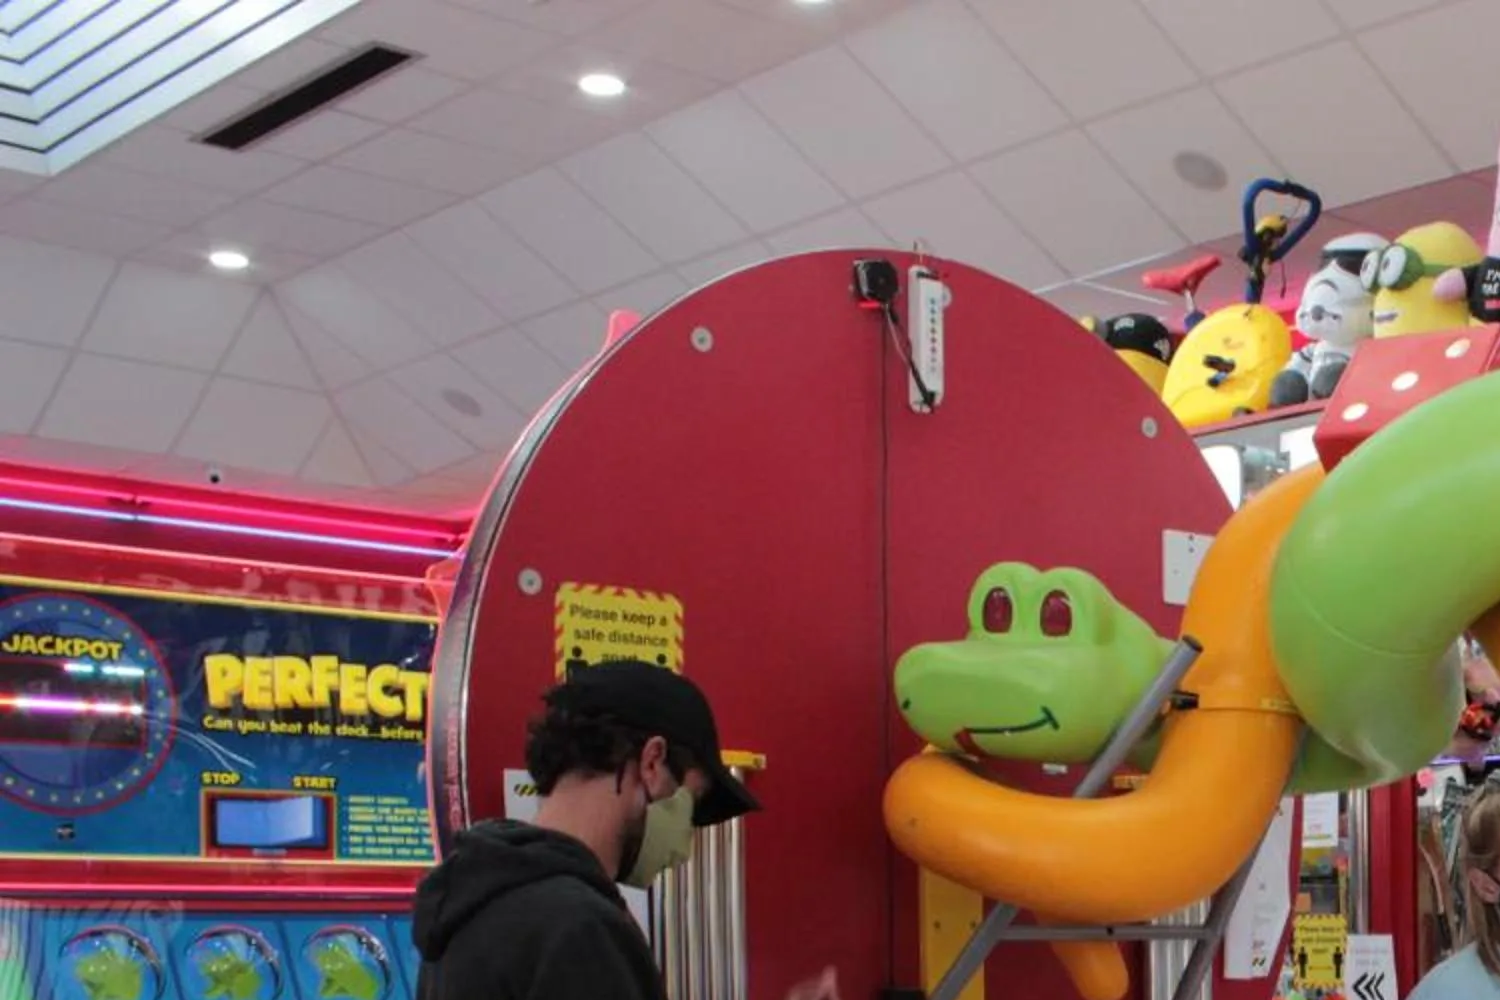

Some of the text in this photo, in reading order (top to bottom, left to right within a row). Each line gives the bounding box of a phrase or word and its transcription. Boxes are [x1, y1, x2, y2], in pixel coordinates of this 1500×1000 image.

[569, 604, 668, 627] Please keep a
[2, 632, 123, 660] JACKPOT
[574, 628, 669, 647] safe distance
[204, 654, 429, 722] PERFECT
[203, 715, 232, 730] Can
[237, 719, 266, 735] you
[270, 720, 302, 734] beat
[308, 722, 331, 735] the
[202, 771, 337, 789] STOP START
